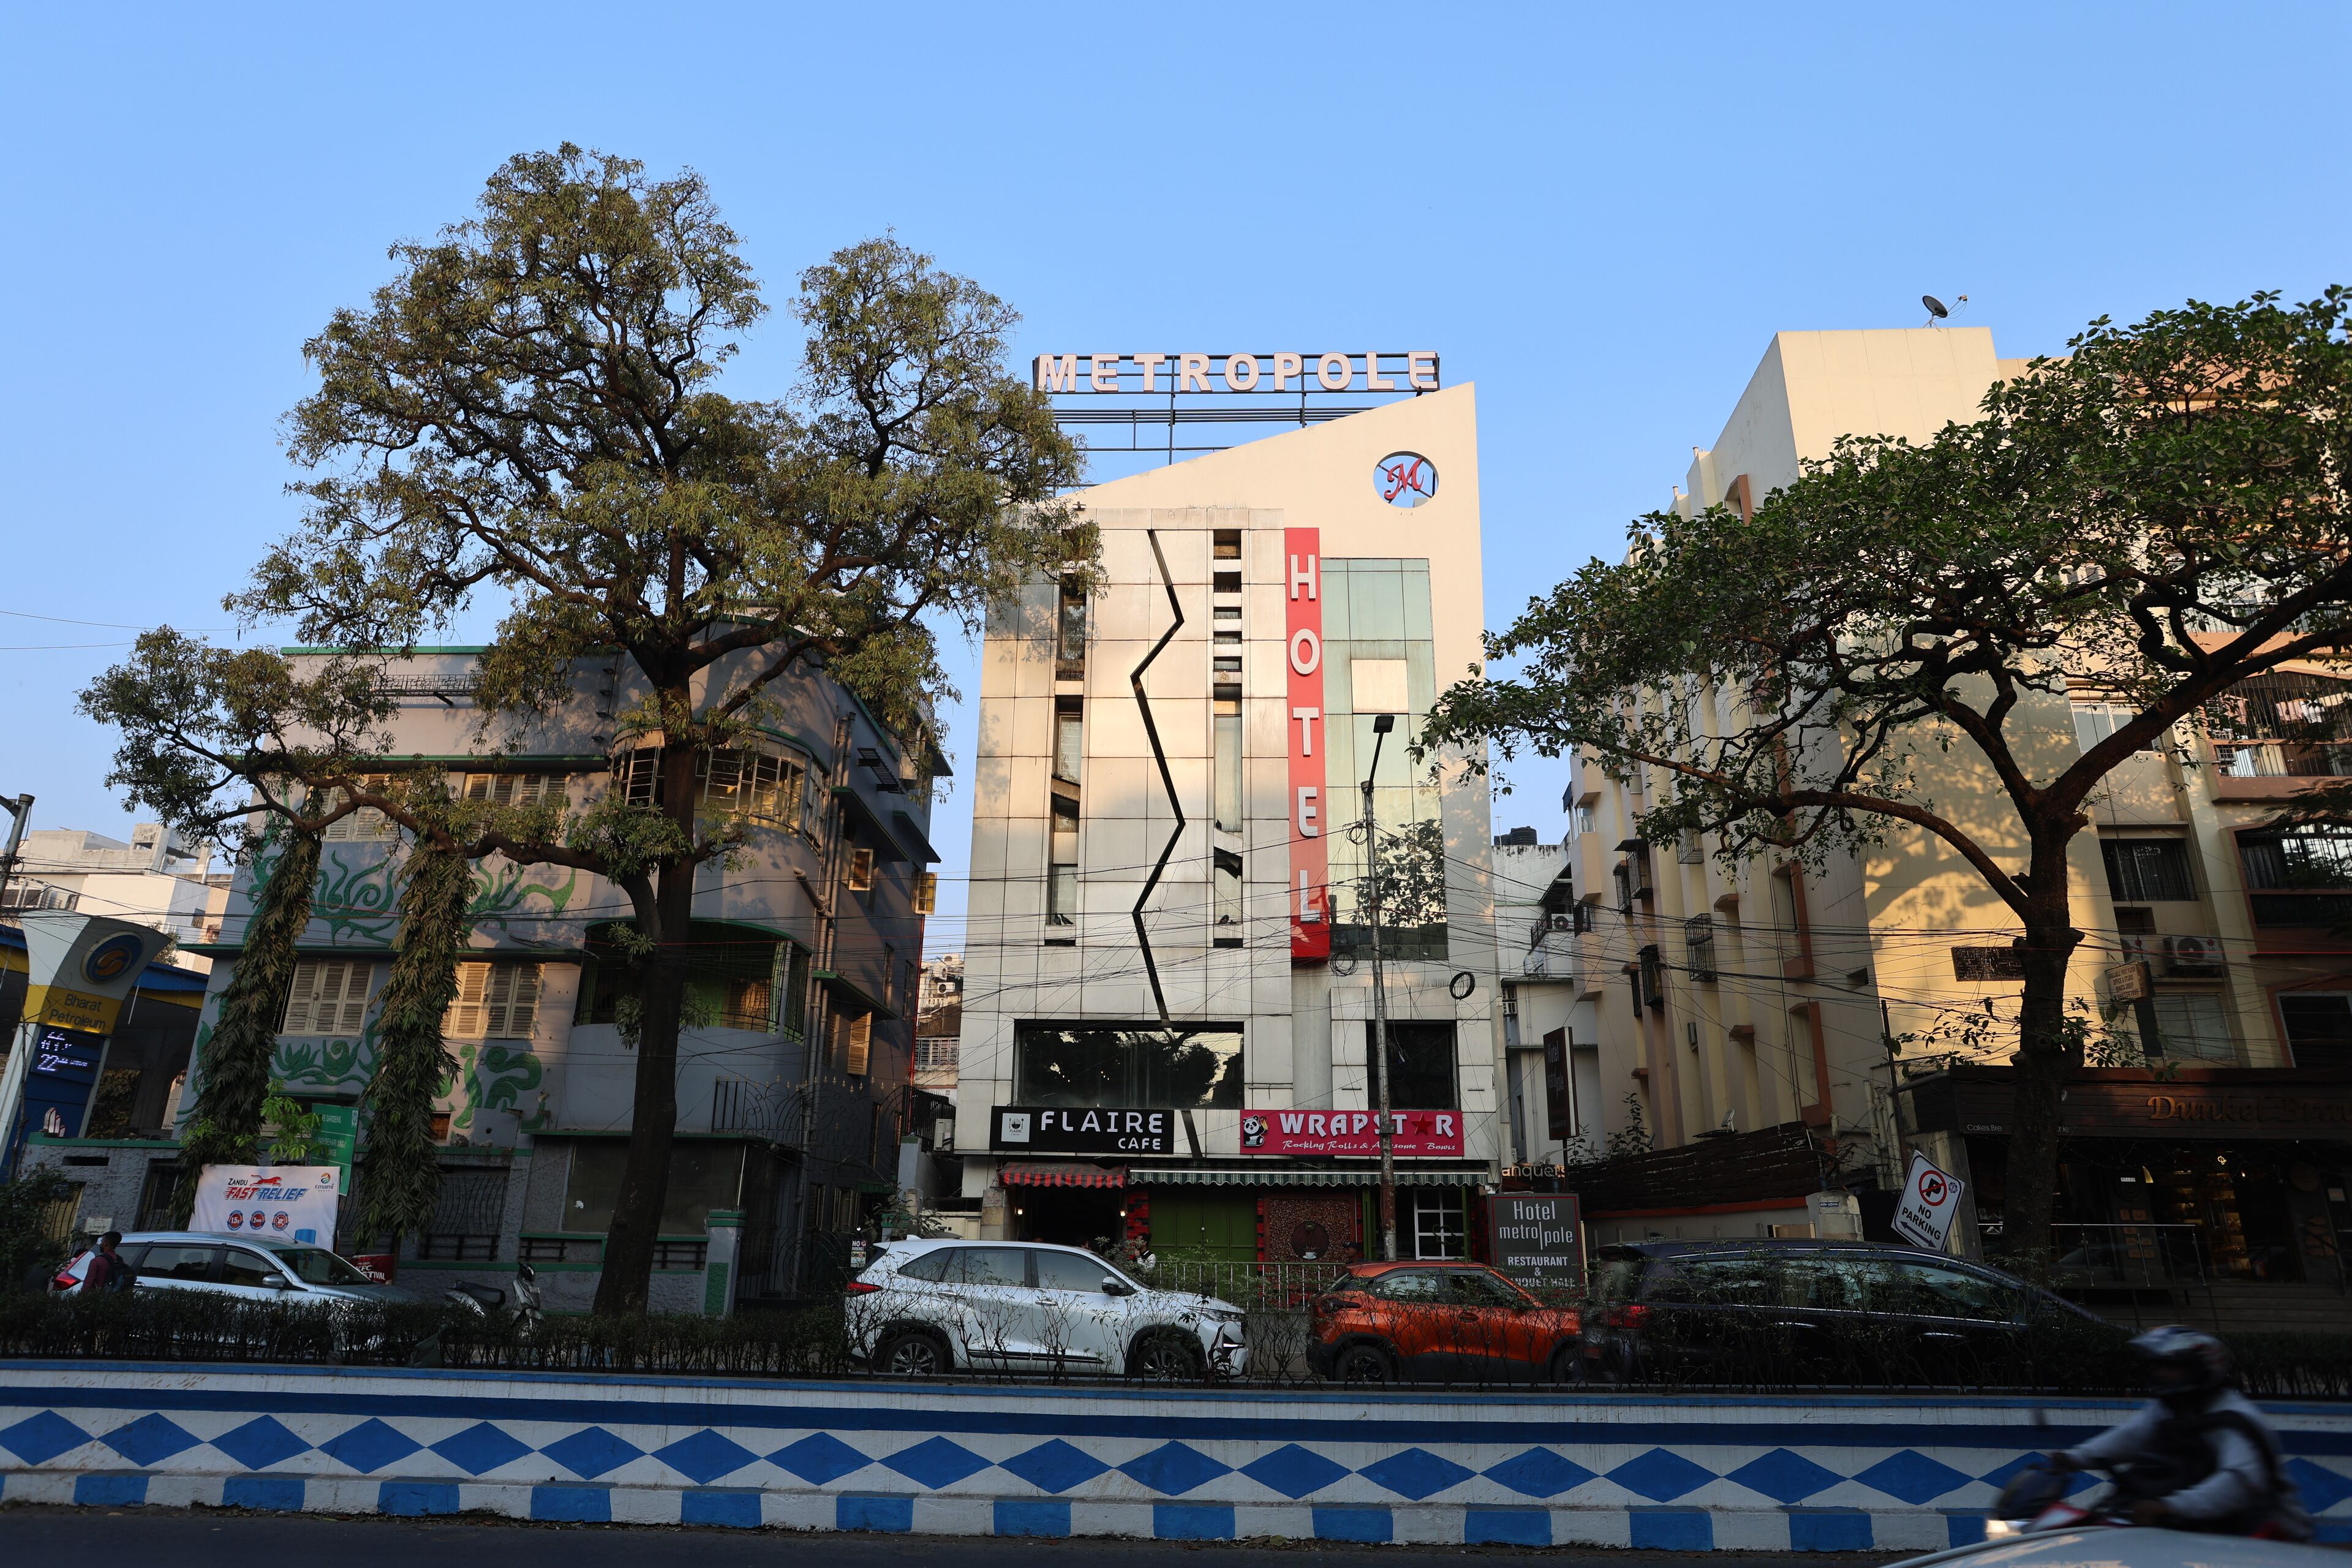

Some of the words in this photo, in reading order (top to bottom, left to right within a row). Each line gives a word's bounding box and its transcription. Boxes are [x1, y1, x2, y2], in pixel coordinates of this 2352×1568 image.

[1038, 351, 1439, 392] METROPOLE
[1290, 554, 1320, 924] HOTEL
[64, 993, 102, 1012] Bharat
[48, 1009, 106, 1030] Petroleum
[2146, 1095, 2269, 1121] Dunkel
[1041, 1110, 1163, 1133] FLAIRE
[1118, 1137, 1161, 1150] CAFE
[1283, 1140, 1325, 1151] Rocking
[1327, 1140, 1358, 1151] Rolls
[1370, 1141, 1417, 1151] Asome
[1502, 1165, 1566, 1181] anquets
[224, 1186, 260, 1200] FAST
[257, 1188, 309, 1201] RELIEF
[1513, 1200, 1556, 1220] Hotel
[1918, 1204, 1932, 1219] NO
[1902, 1207, 1941, 1240] PARKING
[1507, 1256, 1568, 1266] RESTAURANT
[1534, 1267, 1542, 1276] &
